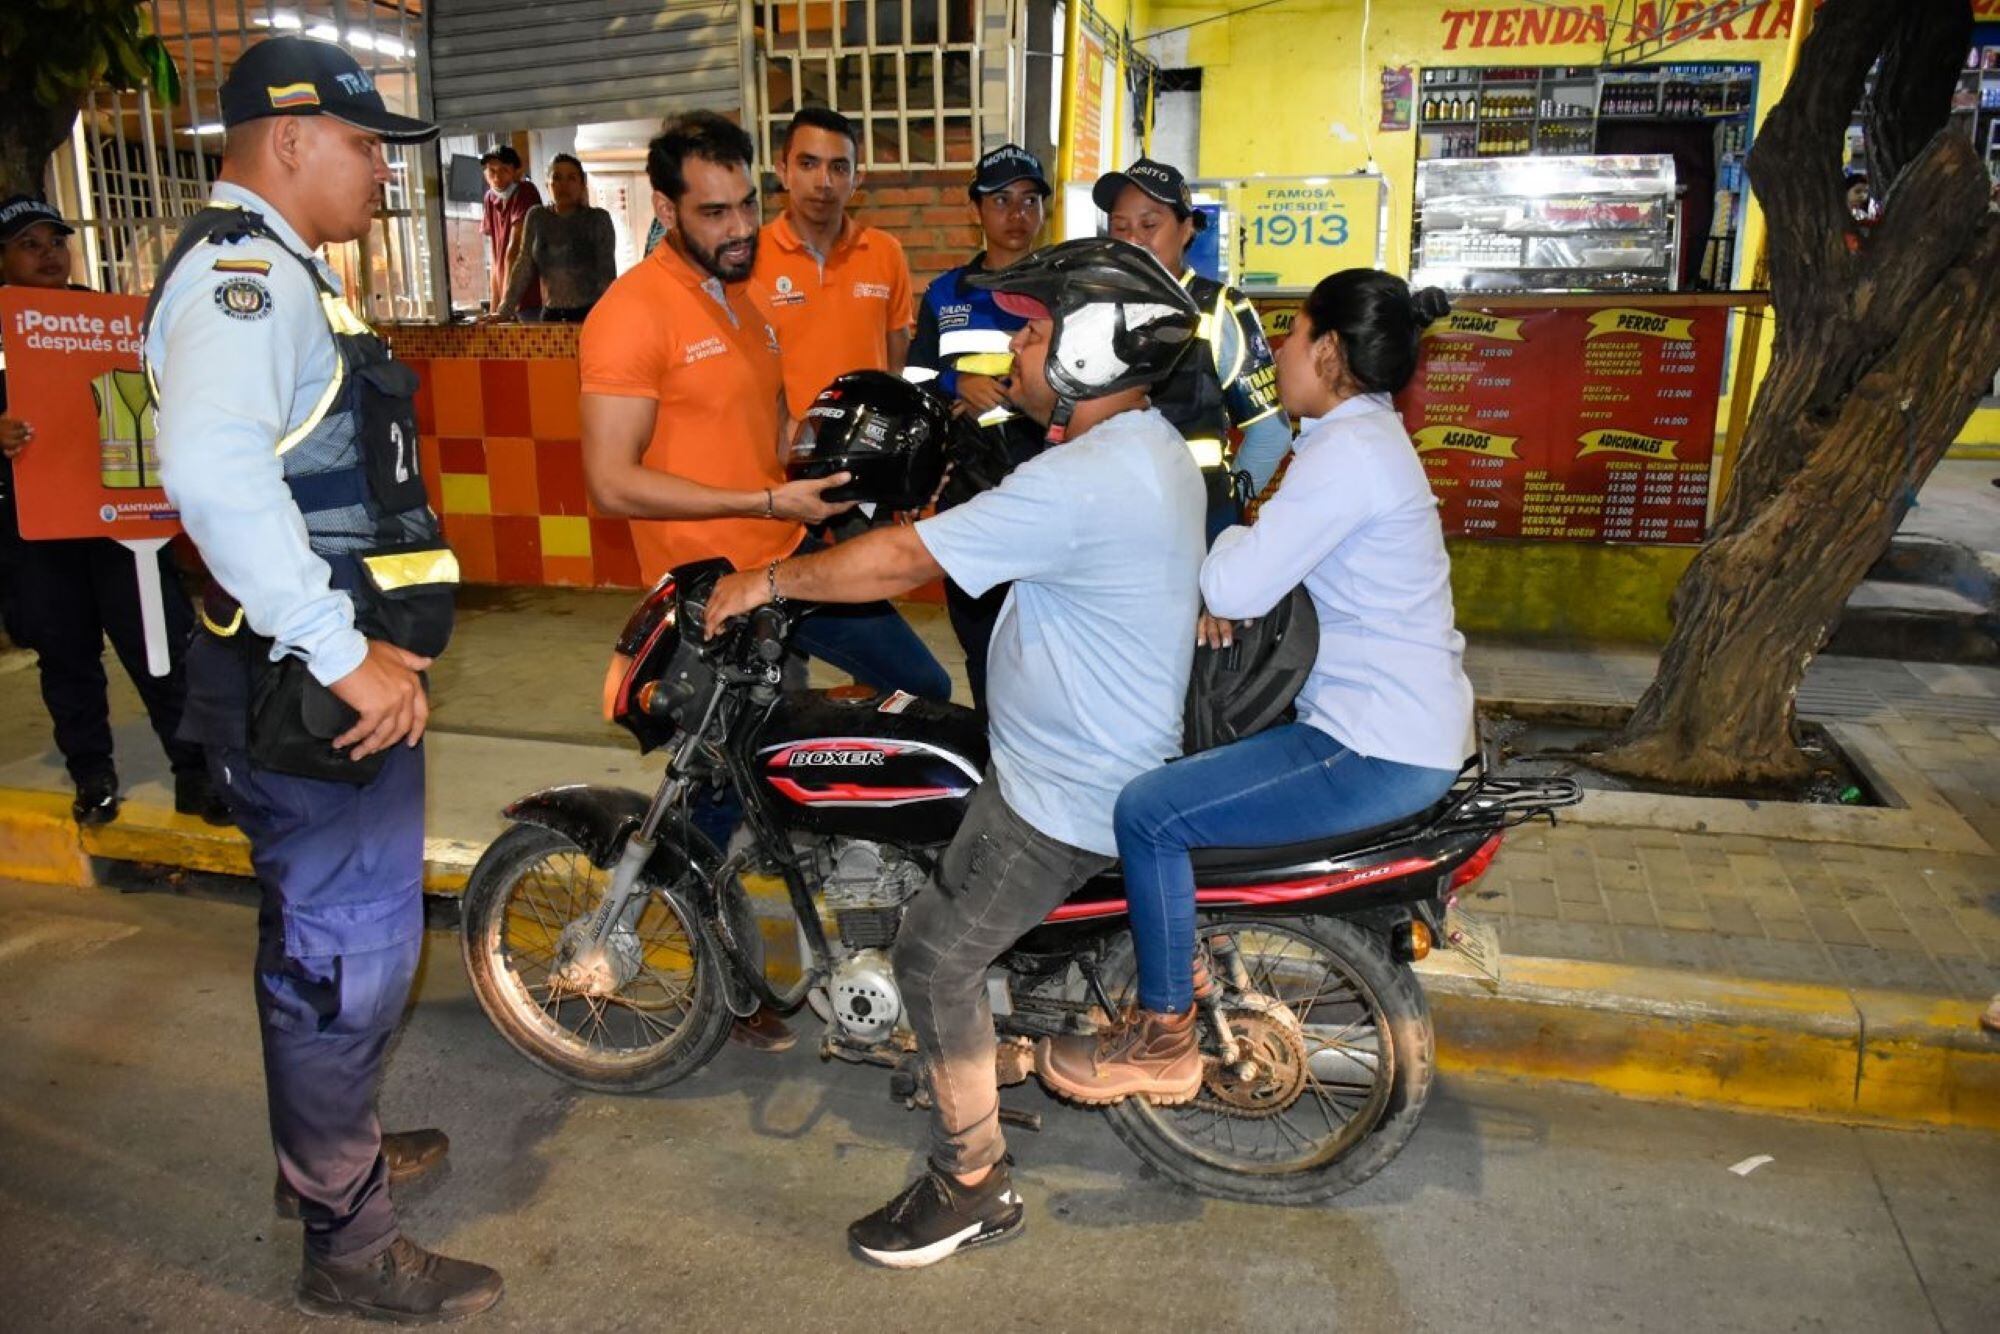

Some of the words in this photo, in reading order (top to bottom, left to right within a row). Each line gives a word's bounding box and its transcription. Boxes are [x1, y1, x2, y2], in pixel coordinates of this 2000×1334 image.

[1441, 5, 1606, 50] TIENDA
[1267, 188, 1335, 199] FAMOSA
[1273, 202, 1329, 211] DESDE
[1252, 214, 1349, 245] 1913
[15, 310, 105, 334] ¡Ponte
[110, 315, 133, 335] el
[1450, 316, 1499, 333] PICADAS
[1617, 314, 1669, 332] PERROS
[27, 332, 113, 354] después
[1442, 432, 1491, 449] ASADOS
[1598, 433, 1664, 453] ADICIONALES
[789, 750, 885, 766] BOXER
